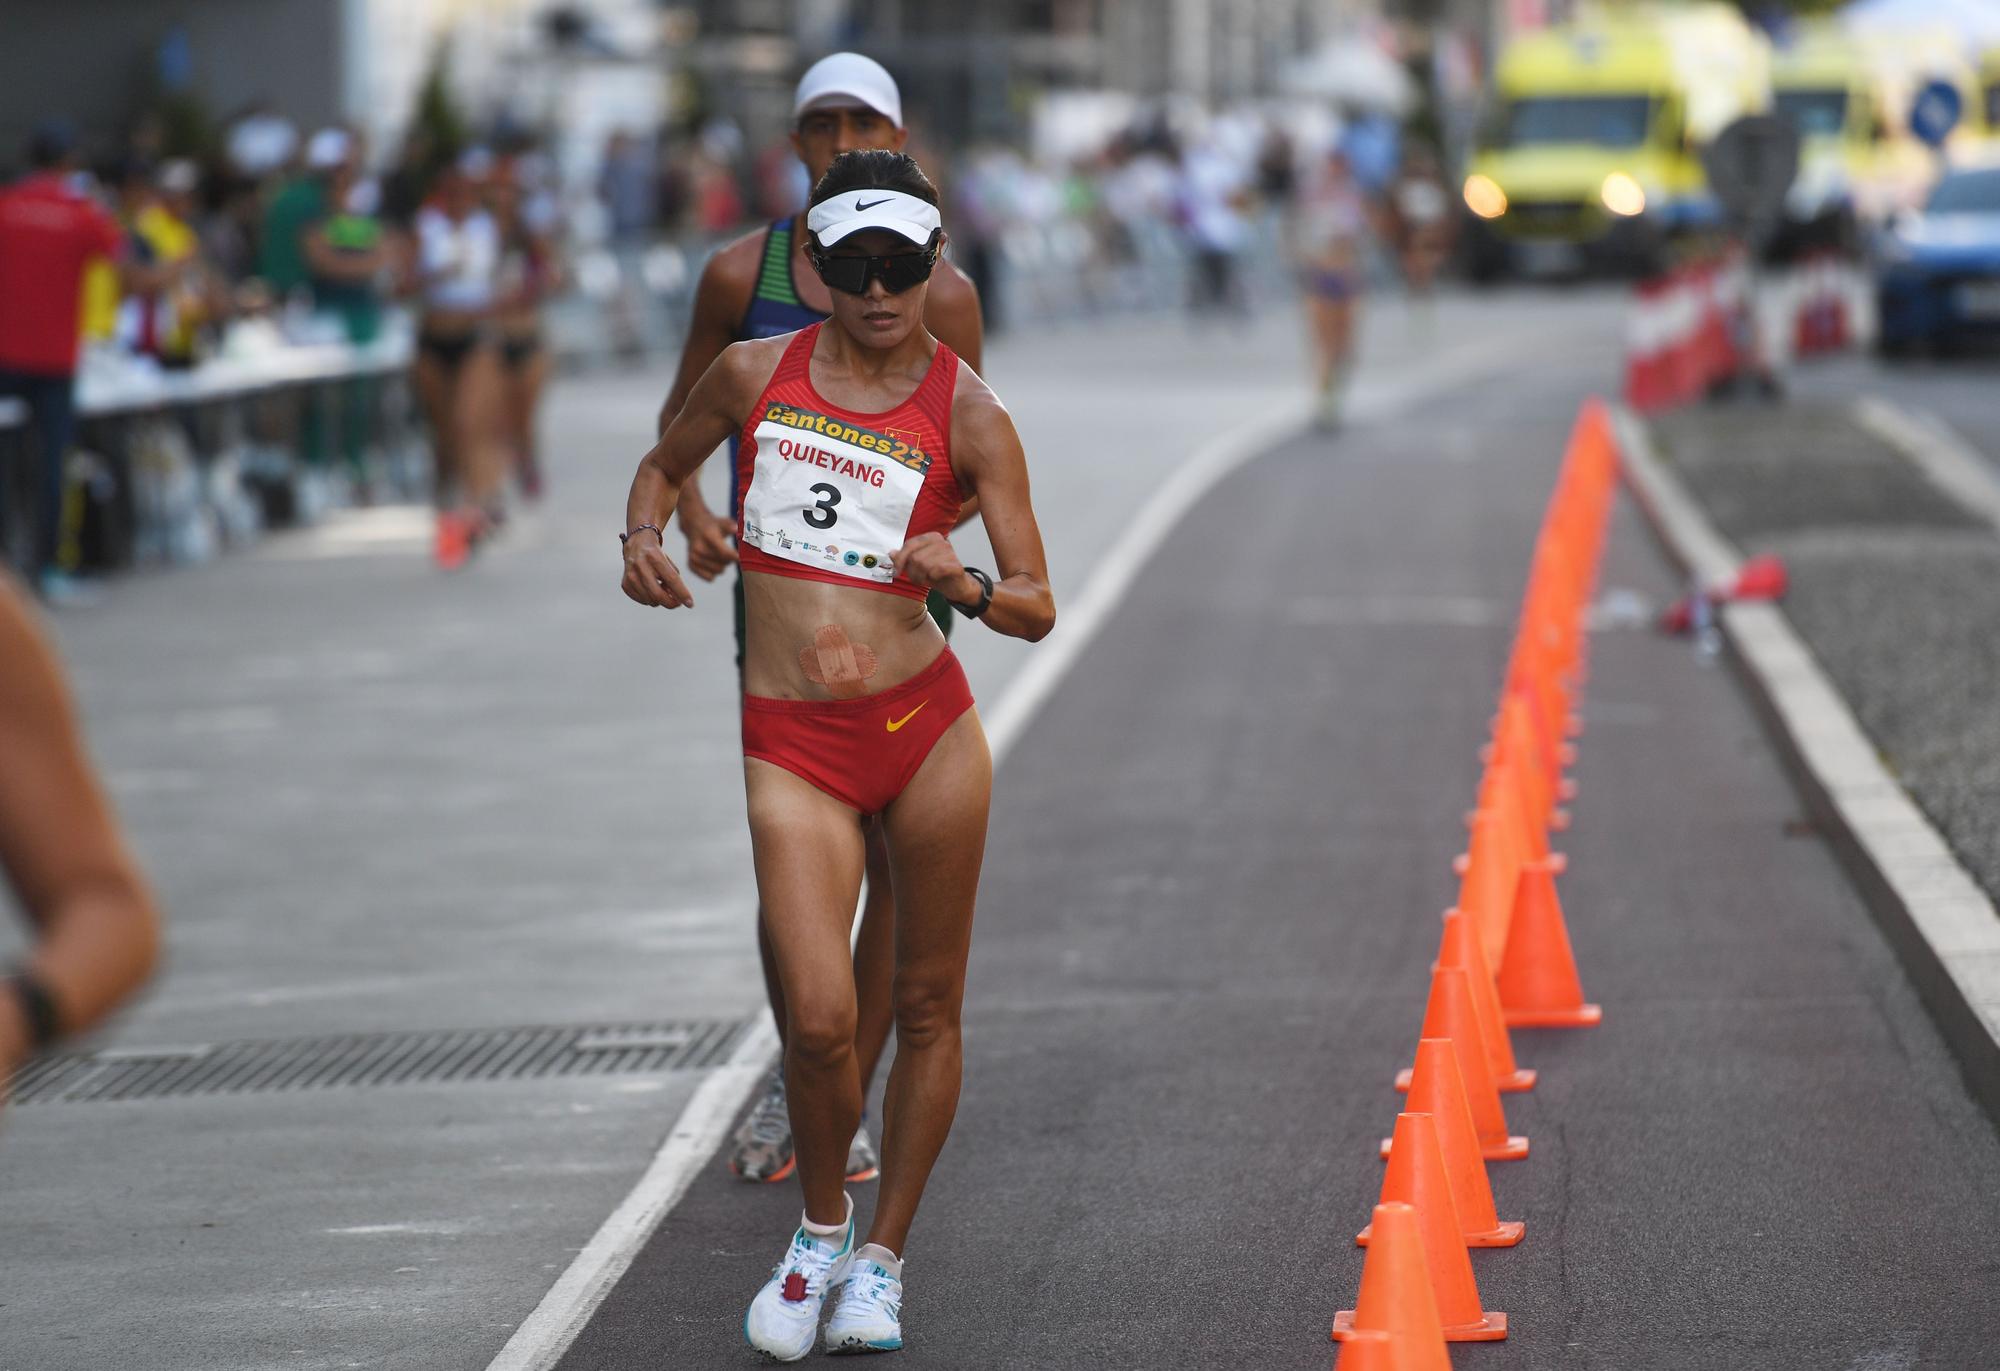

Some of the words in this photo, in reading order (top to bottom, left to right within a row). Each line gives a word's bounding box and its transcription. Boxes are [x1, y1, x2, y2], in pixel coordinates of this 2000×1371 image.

[766, 405, 926, 470] cantones22
[778, 439, 885, 488] QUIEYANG
[802, 482, 842, 530] 3
